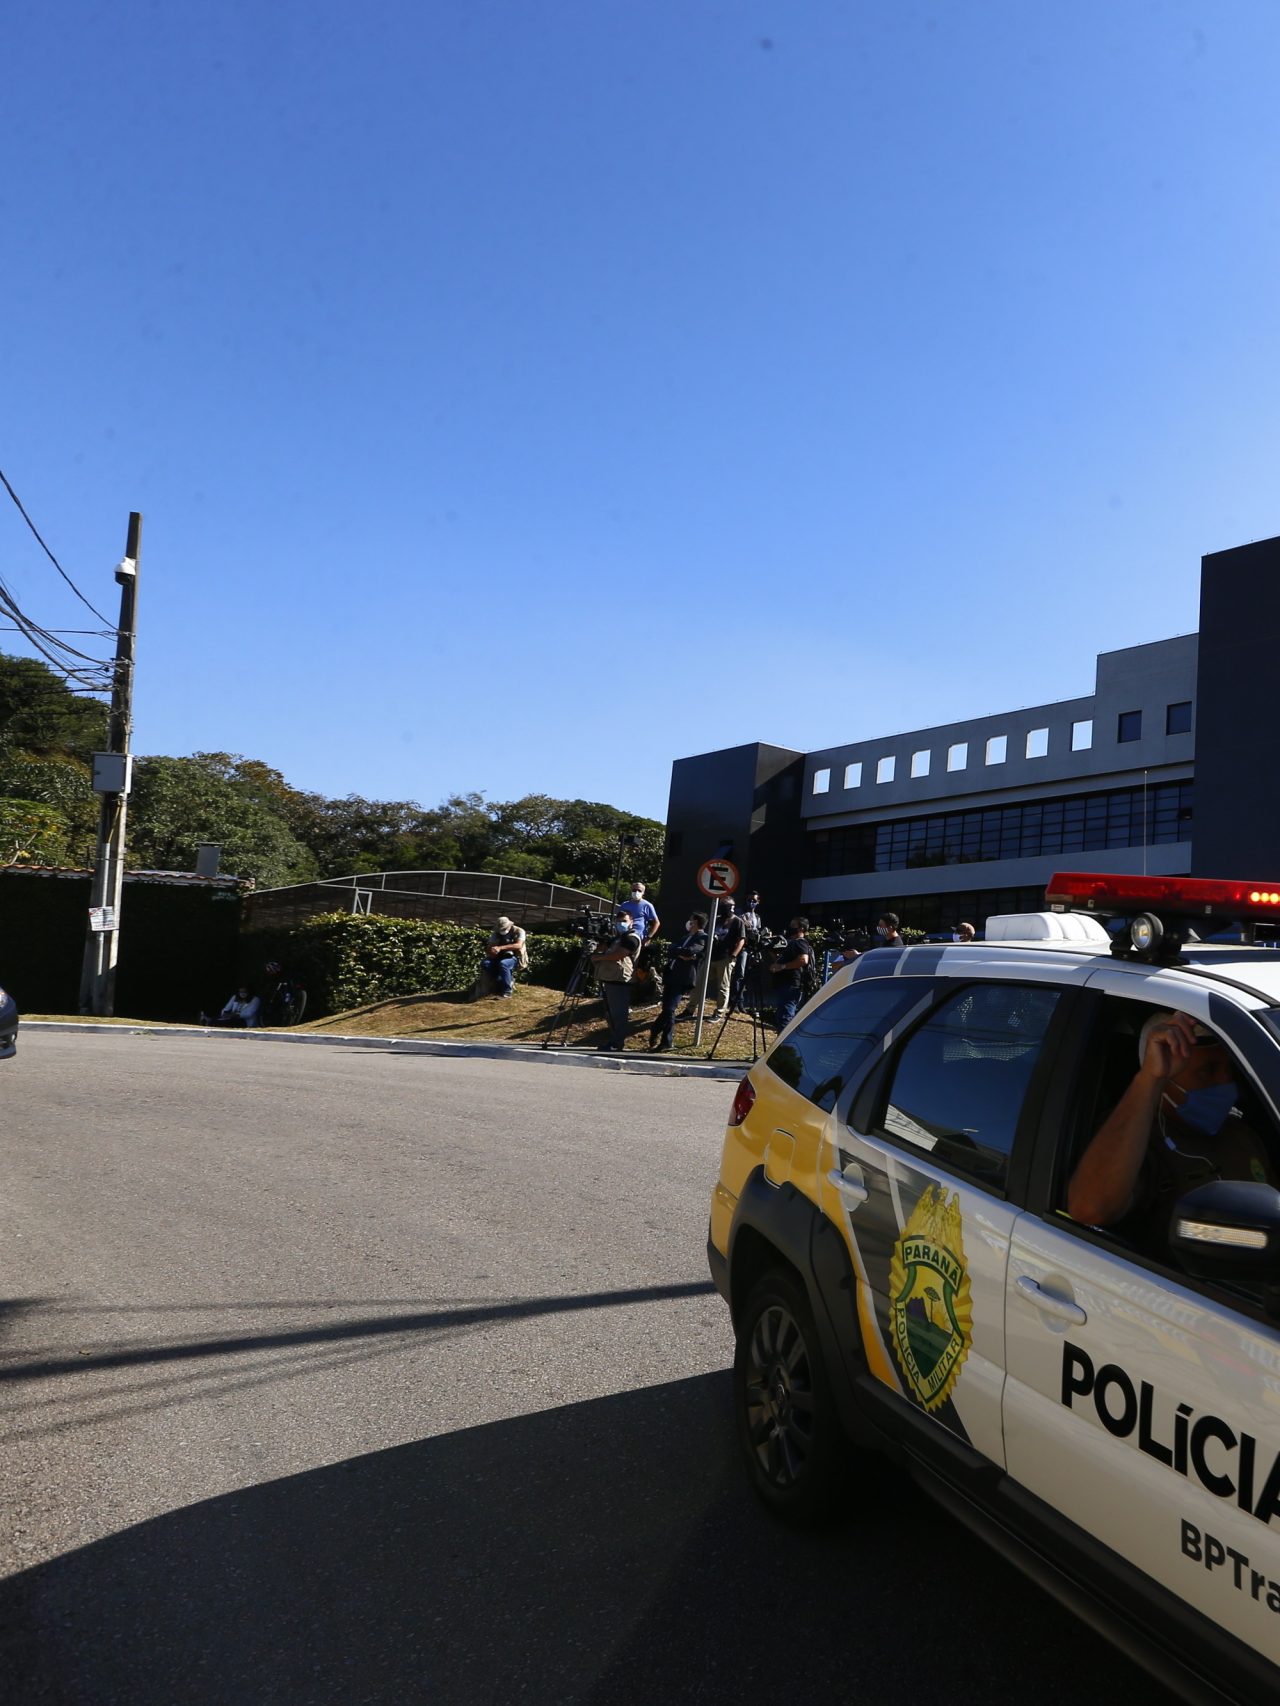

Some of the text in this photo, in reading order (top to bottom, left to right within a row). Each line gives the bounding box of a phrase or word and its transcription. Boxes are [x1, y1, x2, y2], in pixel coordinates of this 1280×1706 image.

[709, 866, 729, 891] E
[904, 1244, 960, 1283] PARANÁ
[927, 1338, 960, 1393] MILITAR
